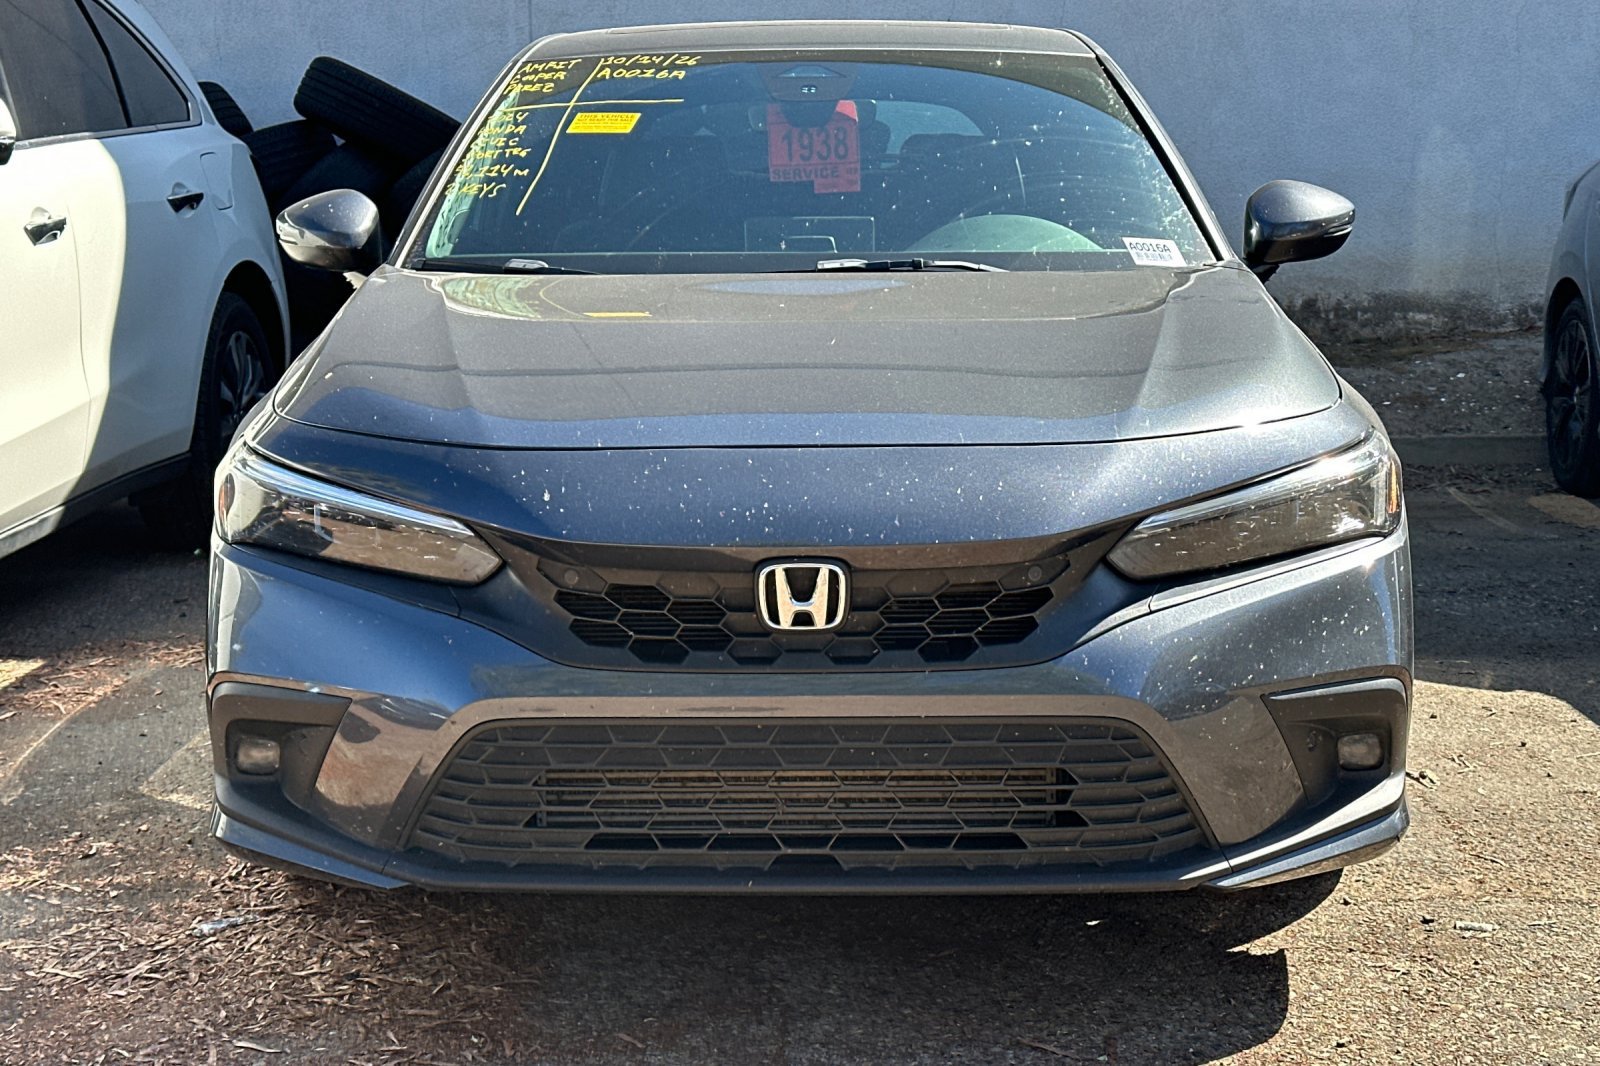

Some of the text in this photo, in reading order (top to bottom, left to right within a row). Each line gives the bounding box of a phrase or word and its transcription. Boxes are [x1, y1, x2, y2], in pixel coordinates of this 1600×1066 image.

[597, 67, 686, 80] A0016A
[782, 125, 849, 161] 1938
[772, 167, 840, 180] SERVICE
[458, 181, 507, 198] KEYS
[1129, 242, 1171, 253] A0016A
